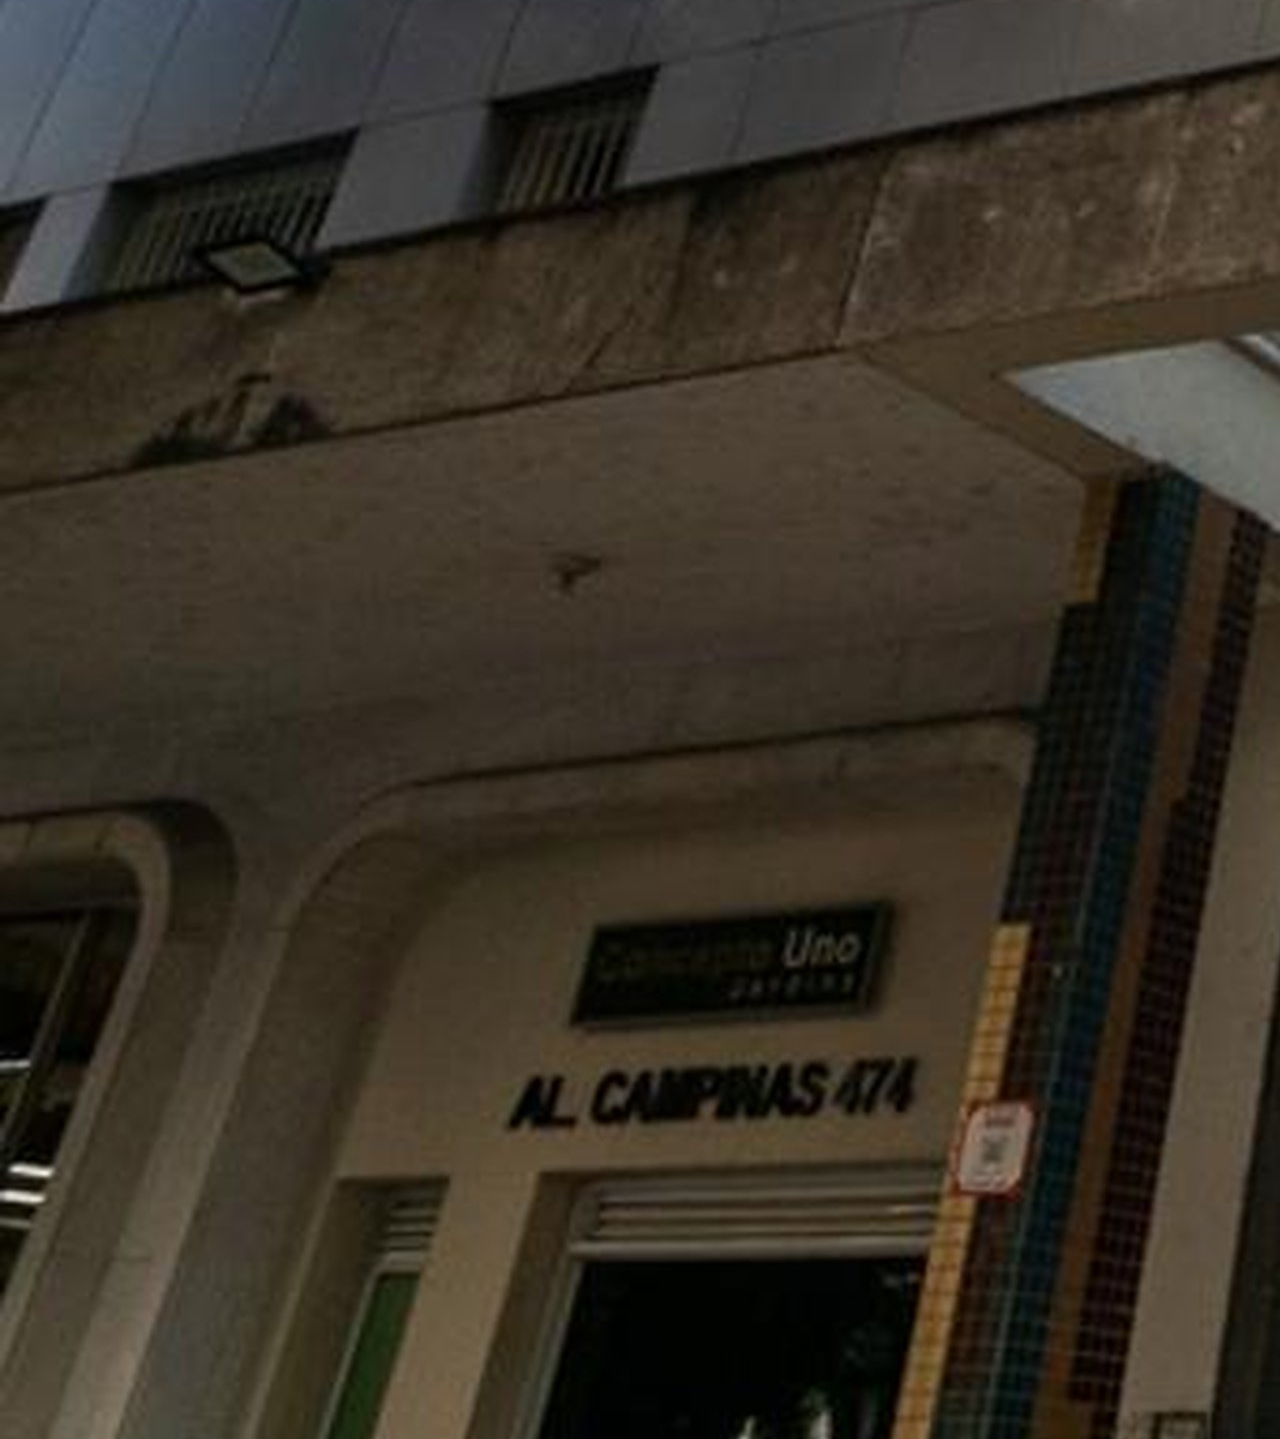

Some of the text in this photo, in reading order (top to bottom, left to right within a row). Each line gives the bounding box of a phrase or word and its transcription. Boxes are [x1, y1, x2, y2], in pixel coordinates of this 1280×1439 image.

[782, 926, 862, 969] Uno
[590, 1060, 830, 1126] CAMPINAS
[832, 1057, 919, 1115] 474
